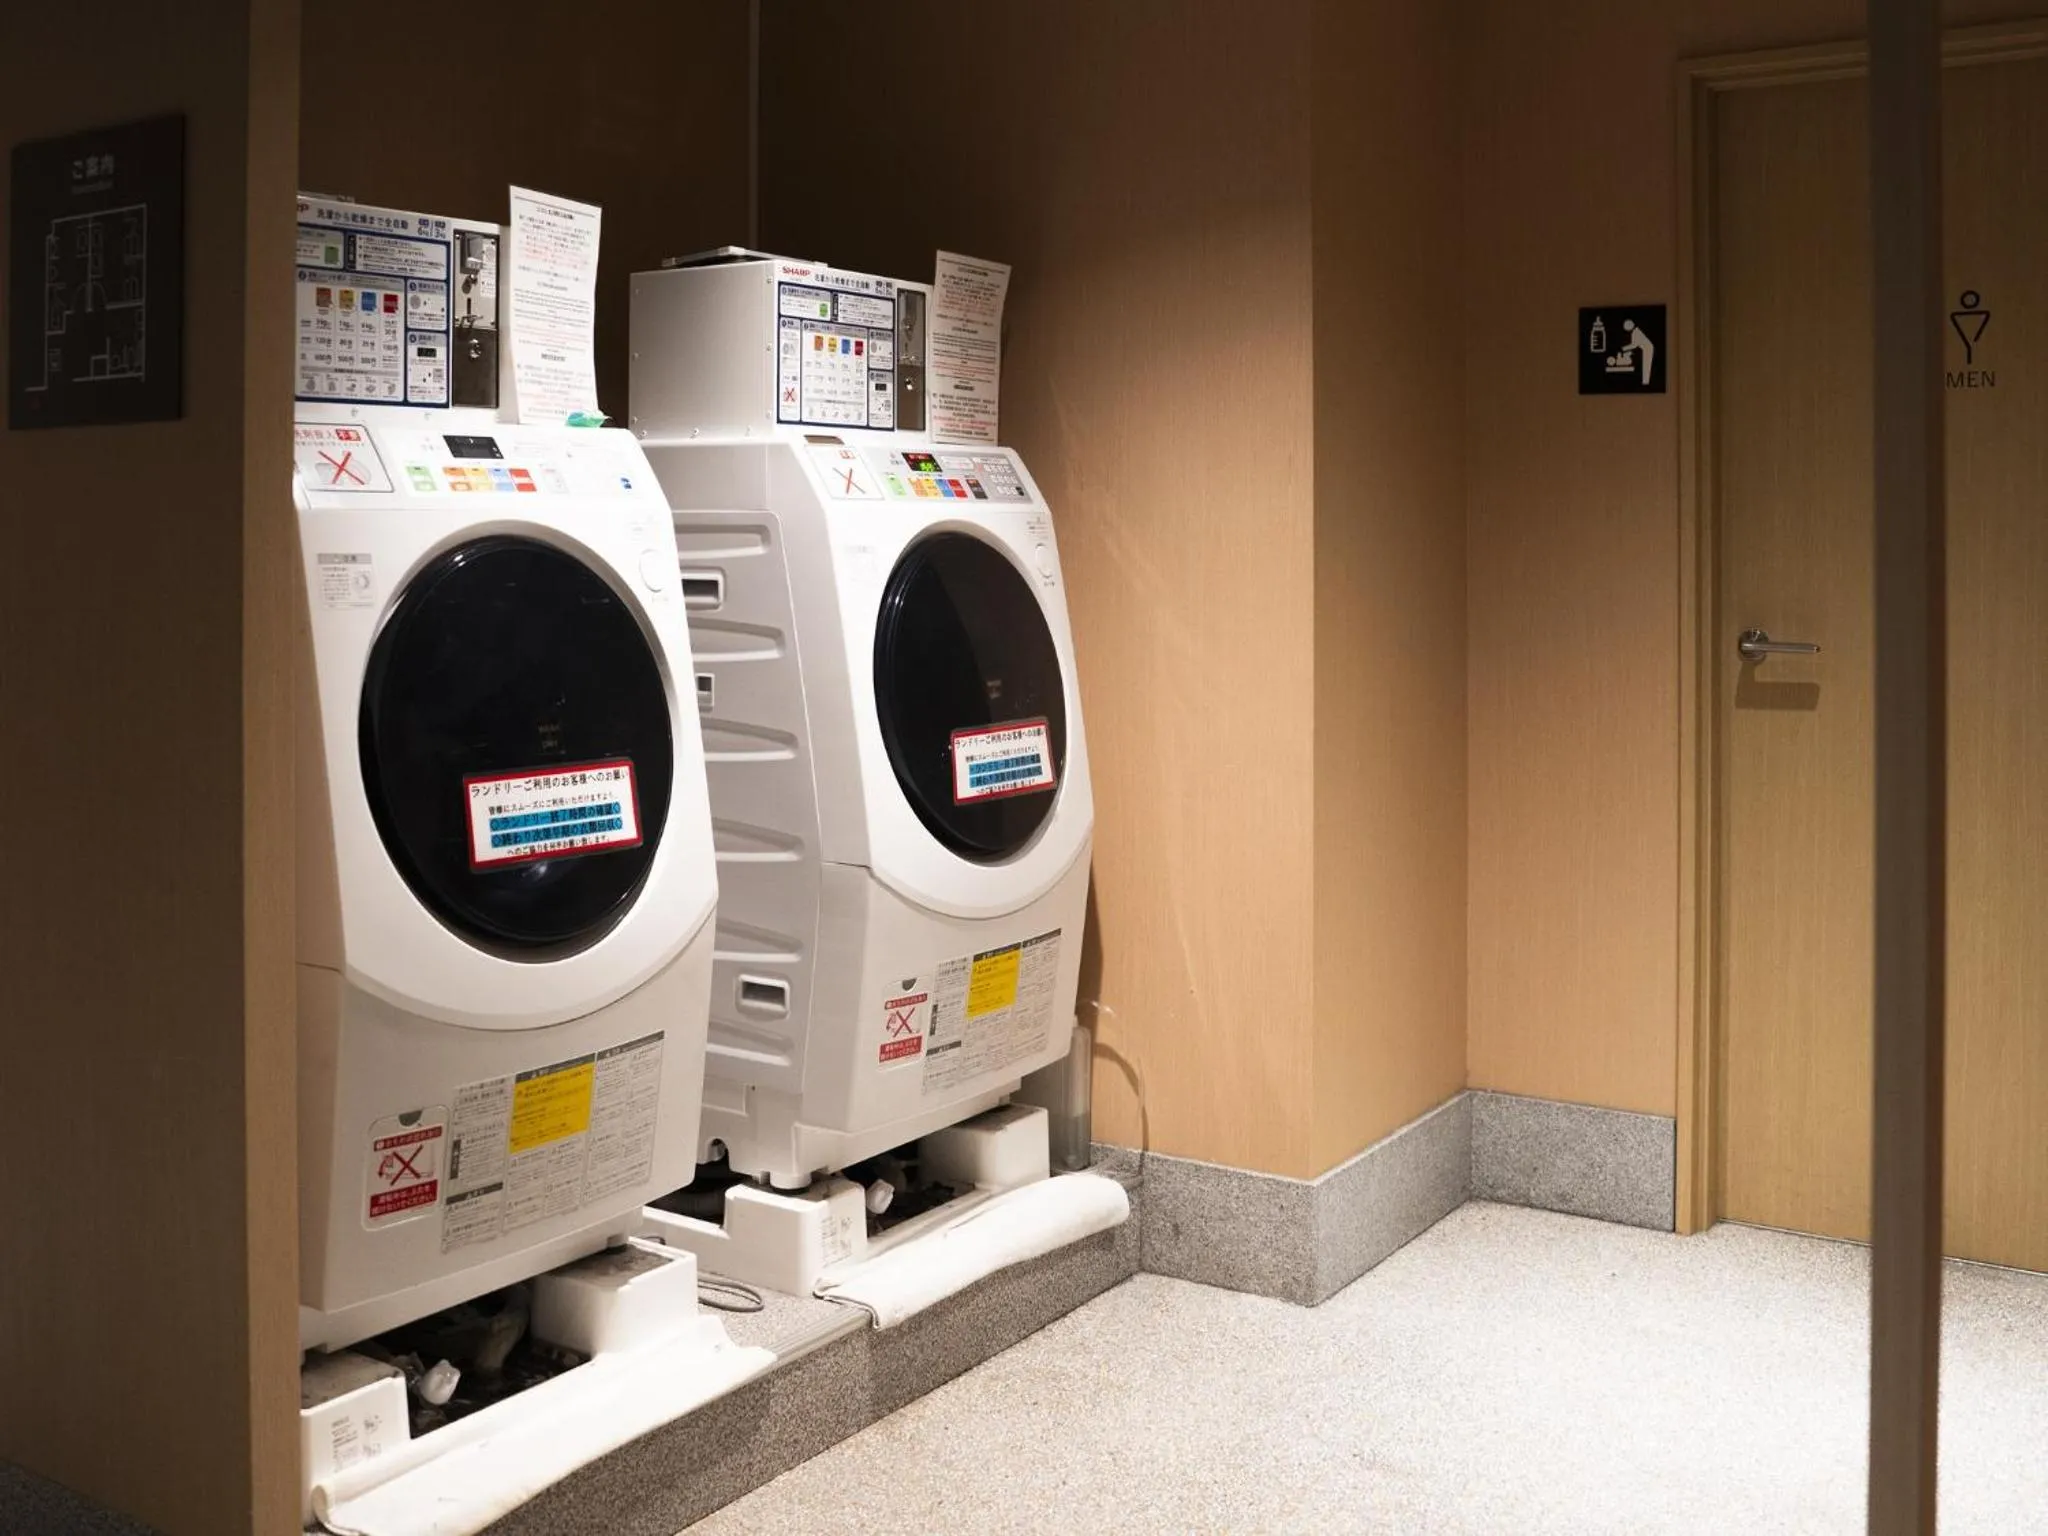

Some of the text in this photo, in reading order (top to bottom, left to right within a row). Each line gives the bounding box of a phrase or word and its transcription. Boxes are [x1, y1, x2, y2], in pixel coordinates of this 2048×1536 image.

[782, 265, 811, 277] SHARP
[1946, 371, 1996, 388] MEN
[471, 768, 628, 798] ランドリーご利用のお客様へのお願い
